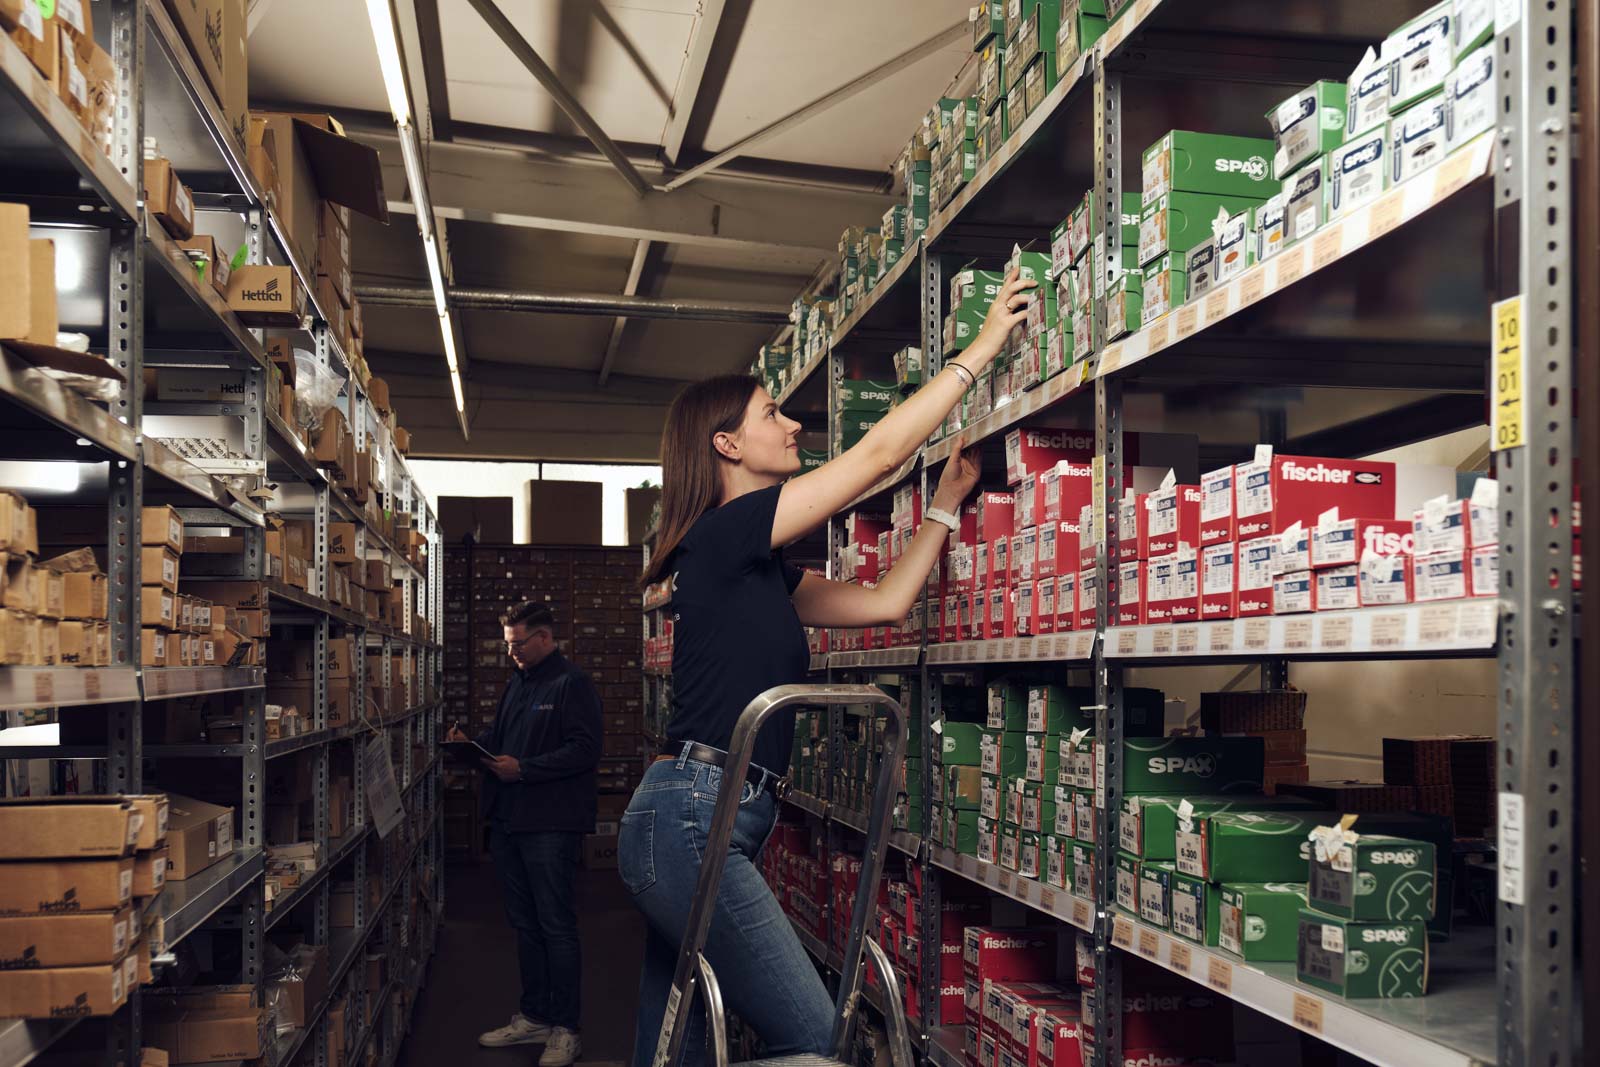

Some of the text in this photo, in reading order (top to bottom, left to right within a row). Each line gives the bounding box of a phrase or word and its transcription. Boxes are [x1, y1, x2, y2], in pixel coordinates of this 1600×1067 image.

[1214, 157, 1266, 178] SPAX
[242, 290, 282, 302] Hettich
[1499, 318, 1518, 341] 10
[221, 384, 245, 394] Hetti
[1498, 371, 1517, 393] 01
[860, 391, 891, 401] SPAX
[859, 421, 876, 431] SP
[1027, 431, 1094, 450] fischer
[1498, 423, 1519, 445] 03
[1281, 461, 1352, 484] fischer
[988, 494, 1014, 505] fisch
[1060, 521, 1080, 533] fisc
[1363, 525, 1415, 557] fisc
[328, 544, 345, 555] tich
[862, 544, 878, 553] fisc
[806, 568, 826, 577] fische
[1149, 756, 1213, 774] SPAX
[1370, 851, 1416, 865] SPAX
[1361, 929, 1408, 943] SPAX
[983, 937, 1028, 950] fischer
[1123, 992, 1183, 1013] scher
